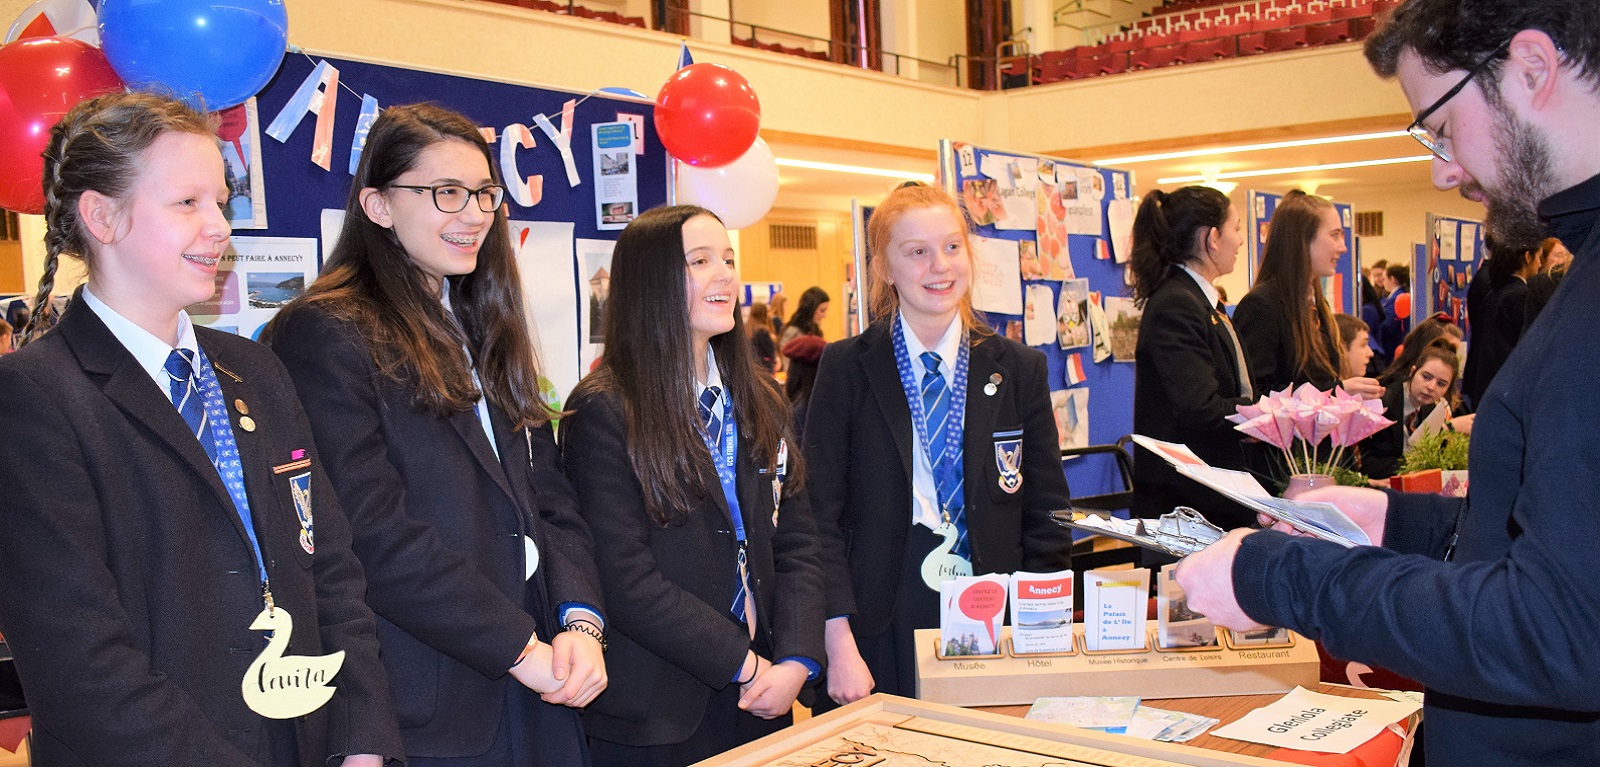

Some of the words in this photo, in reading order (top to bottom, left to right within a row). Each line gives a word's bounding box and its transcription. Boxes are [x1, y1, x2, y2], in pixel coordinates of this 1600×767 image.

[267, 254, 273, 262] À
[726, 438, 734, 455] FORMAL
[726, 455, 734, 467] GCS
[1028, 583, 1062, 595] Annecy
[1162, 654, 1187, 662] Centre
[1188, 653, 1198, 661] de
[1200, 654, 1223, 662] Loisirs
[1238, 650, 1291, 660] Restaurant
[954, 661, 986, 671] Musée
[1027, 659, 1053, 668] Hôtel
[1088, 656, 1112, 666] Musée
[1113, 657, 1149, 667] Historique
[1267, 707, 1327, 734] Glenlola
[1300, 709, 1369, 741] Collegiate
